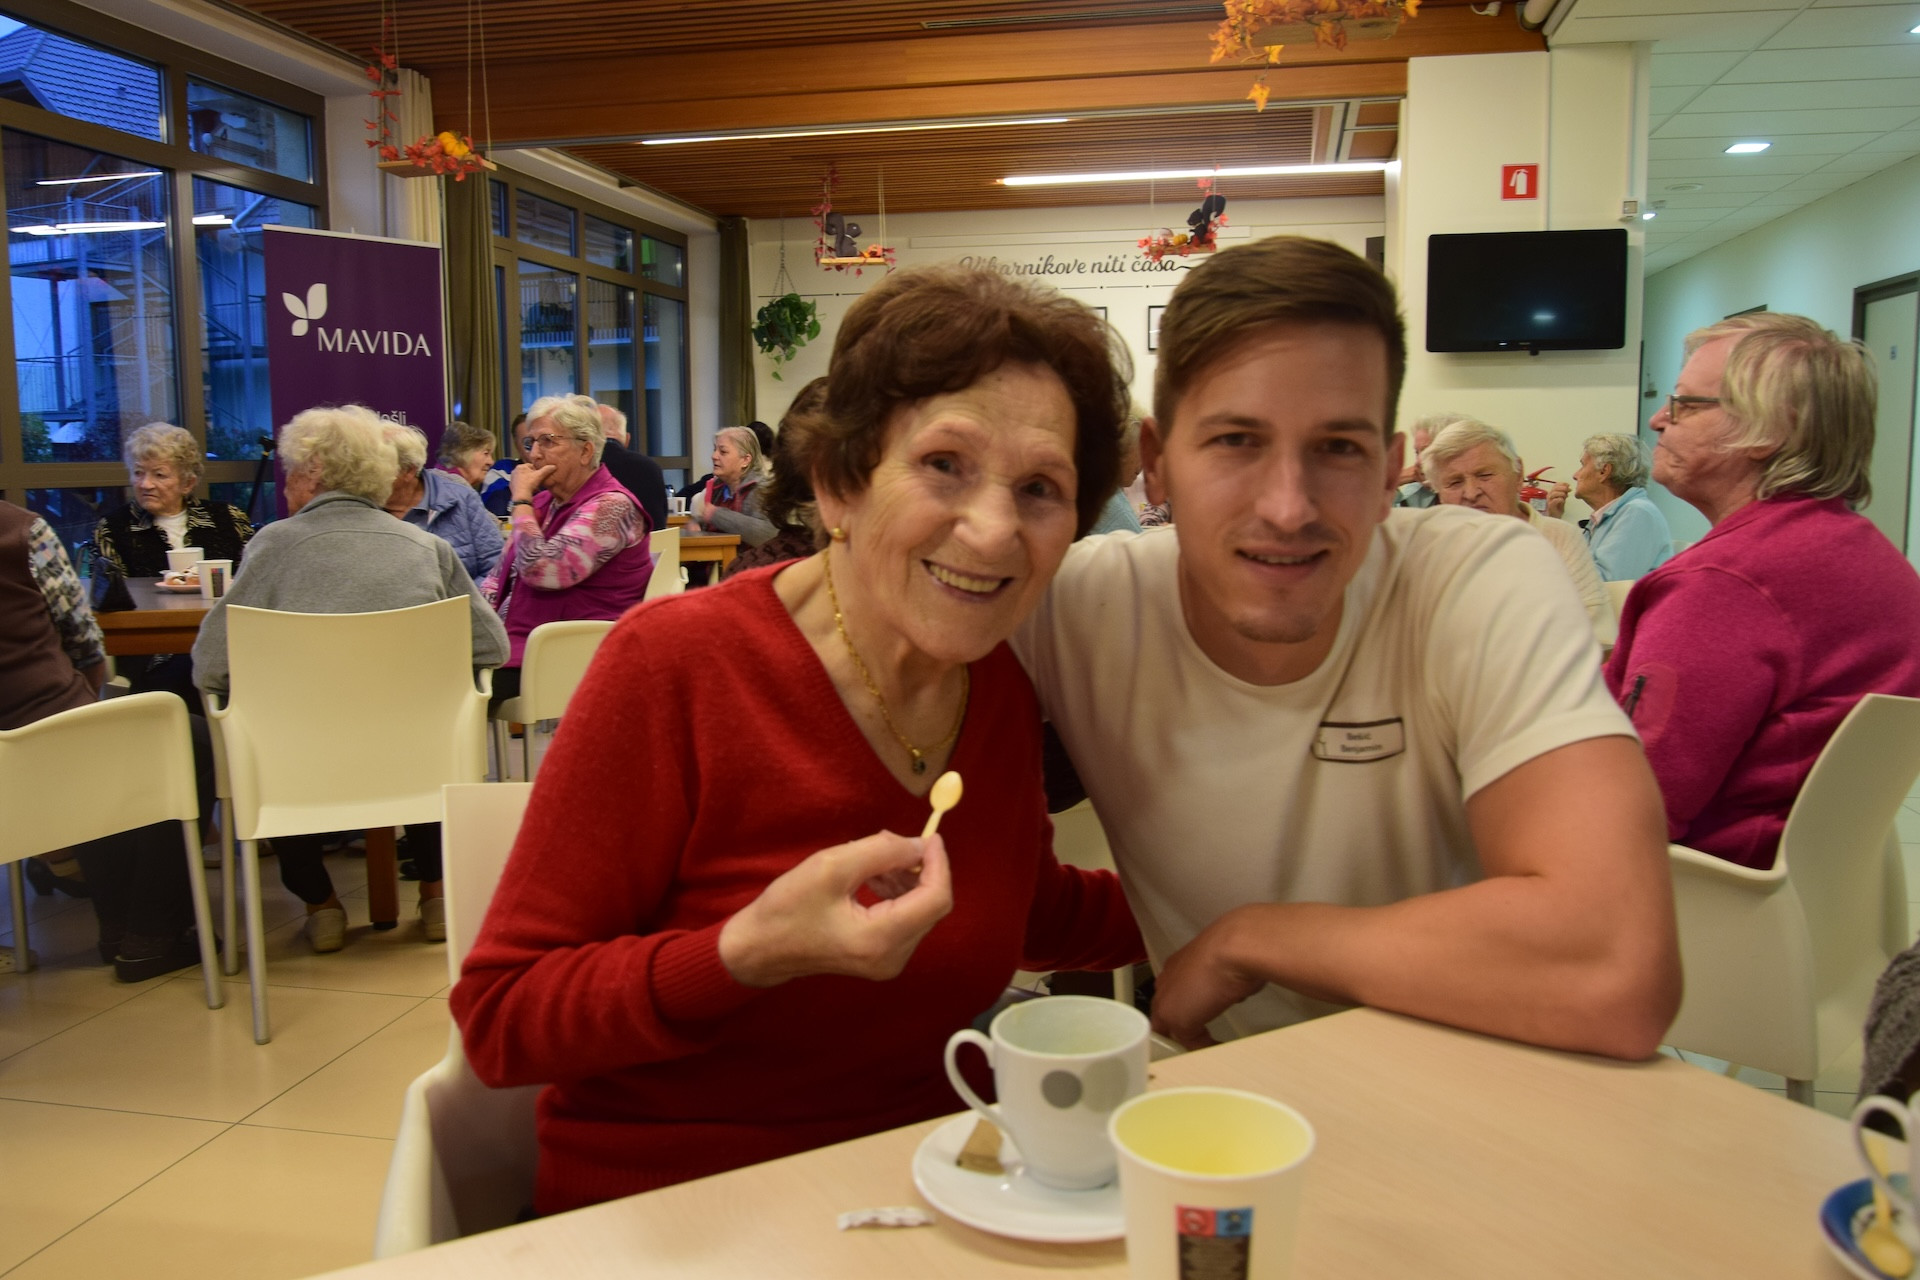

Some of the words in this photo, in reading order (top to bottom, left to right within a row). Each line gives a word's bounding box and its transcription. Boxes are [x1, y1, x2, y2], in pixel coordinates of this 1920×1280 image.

[1090, 254, 1127, 274] niti
[1131, 256, 1177, 273] časa
[317, 326, 432, 357] MAVIDA
